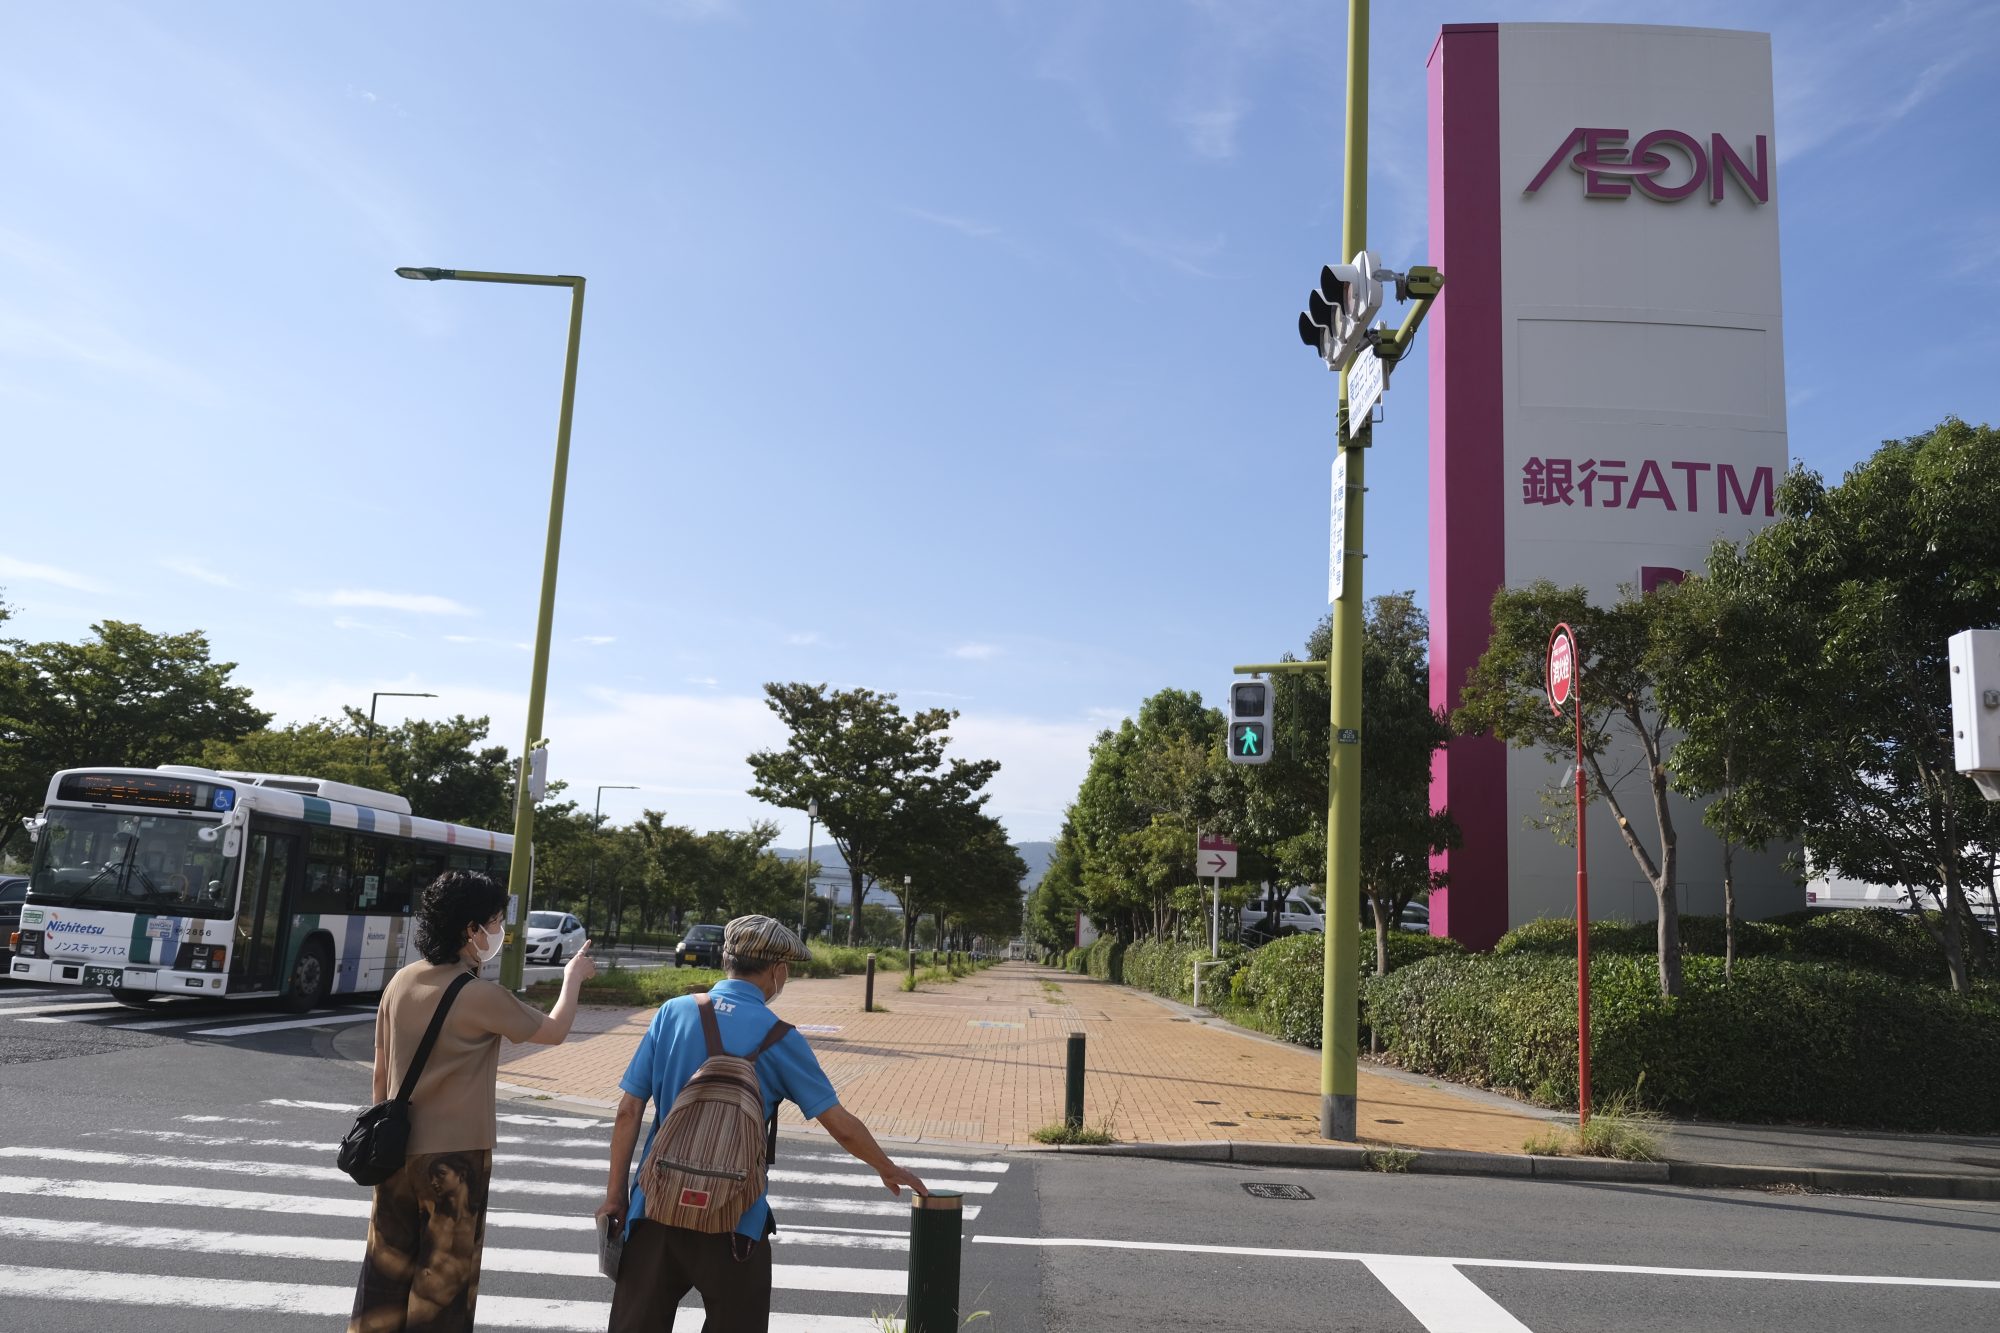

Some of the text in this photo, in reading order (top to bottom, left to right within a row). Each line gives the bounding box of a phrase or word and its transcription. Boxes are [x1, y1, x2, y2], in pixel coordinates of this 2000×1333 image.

[1522, 456, 1776, 518] 銀行ATM
[1552, 655, 1569, 685] 消火栓
[46, 920, 105, 936] Nishitetsu
[186, 928, 212, 937] 2856
[54, 942, 127, 957] ノンステップバス
